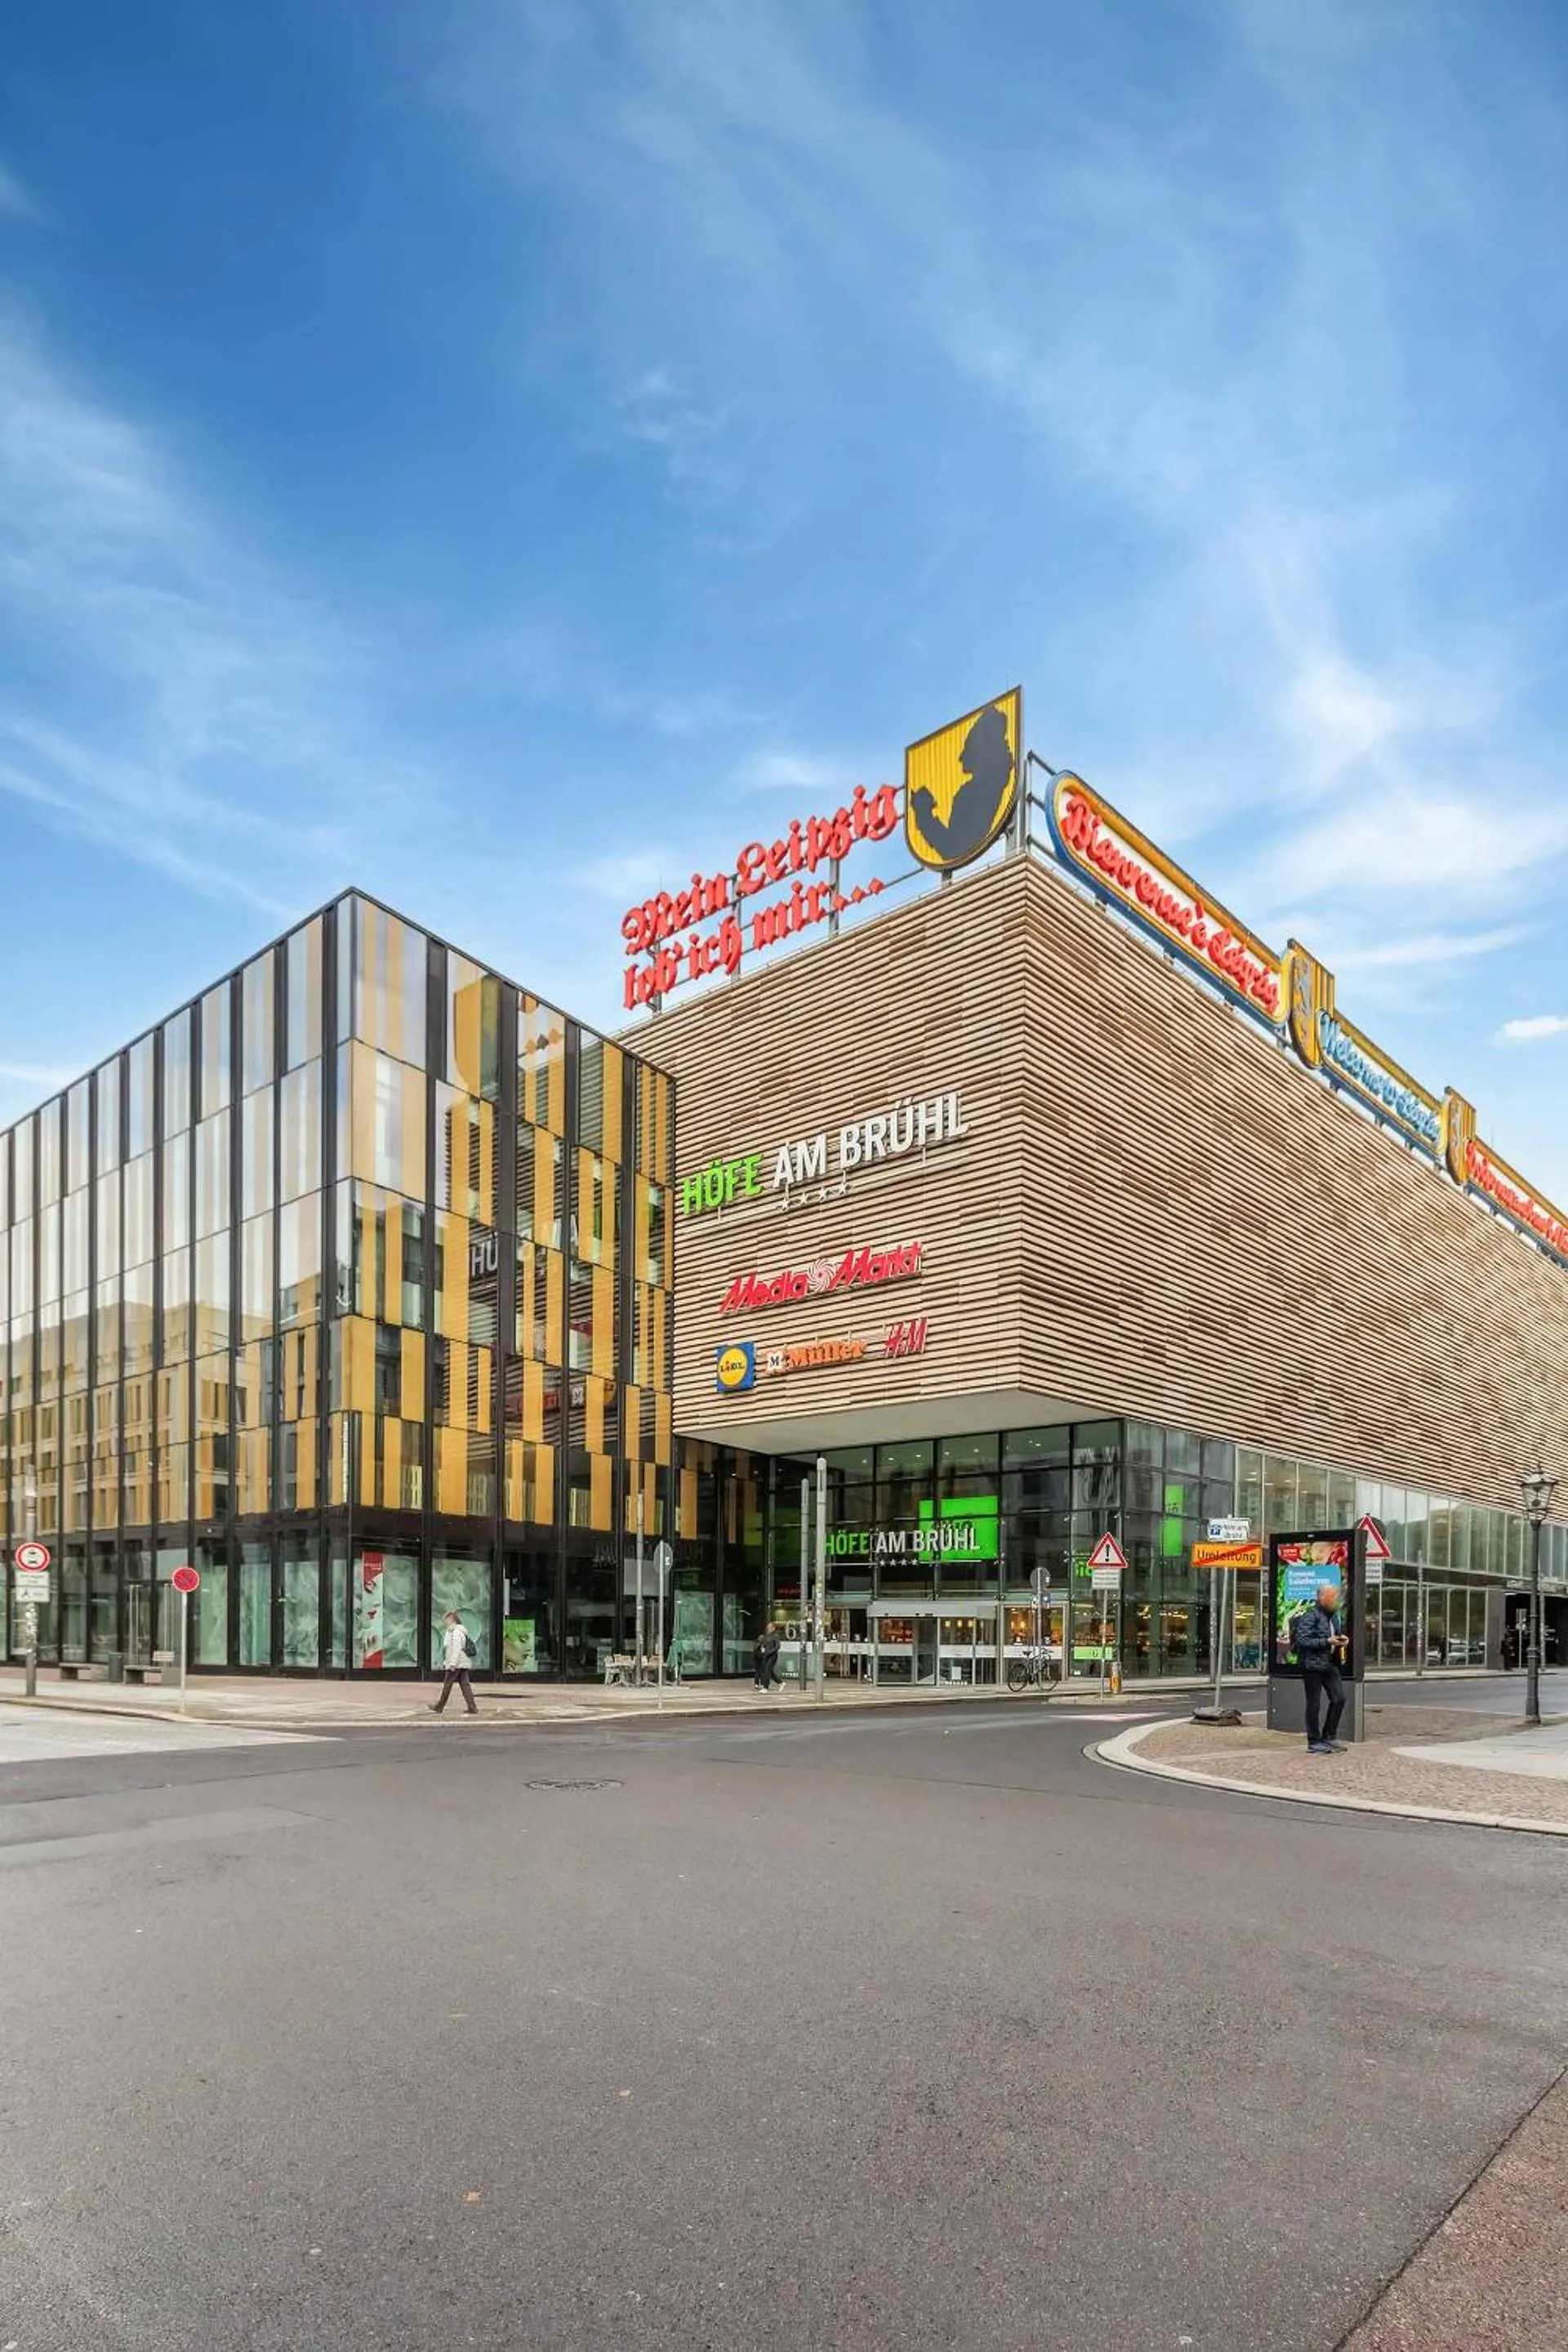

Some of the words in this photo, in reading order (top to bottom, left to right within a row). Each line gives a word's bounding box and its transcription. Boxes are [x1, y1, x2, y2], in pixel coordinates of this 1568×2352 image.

[621, 873, 729, 955] Mein
[737, 784, 898, 898] Leipzig
[688, 915, 742, 980] ich
[682, 1153, 764, 1216] HÖFE
[773, 1131, 828, 1187] AM
[840, 1091, 971, 1170] BRÜHL
[719, 1270, 810, 1315] Media
[826, 1241, 924, 1292] Markt
[826, 1530, 870, 1556] HÖFE
[875, 1530, 906, 1553] AM
[913, 1522, 981, 1552] BRÜHL
[1197, 1549, 1256, 1564] Umleitung
